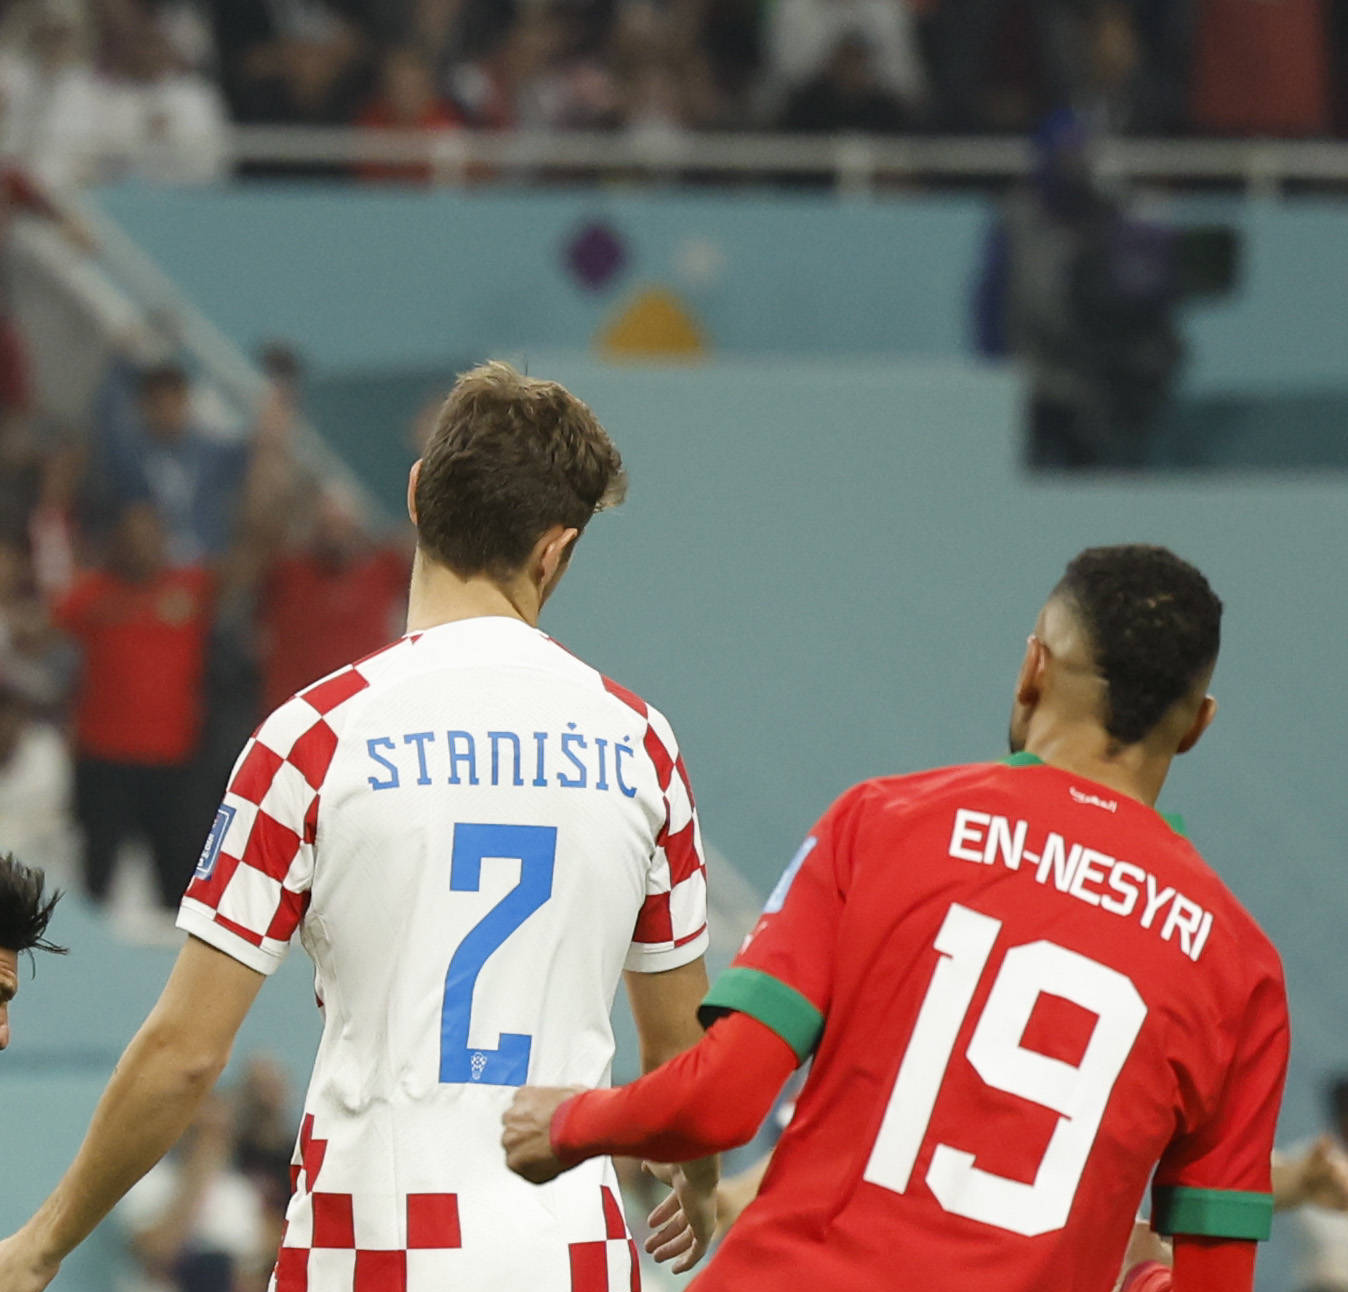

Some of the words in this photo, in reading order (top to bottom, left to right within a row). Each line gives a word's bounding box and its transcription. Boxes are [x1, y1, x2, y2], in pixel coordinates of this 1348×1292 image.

[367, 722, 638, 798] STANIŠIĆ
[439, 822, 558, 1087] 2
[949, 808, 1214, 962] EN-NESYRI
[863, 902, 1149, 1237] 19
